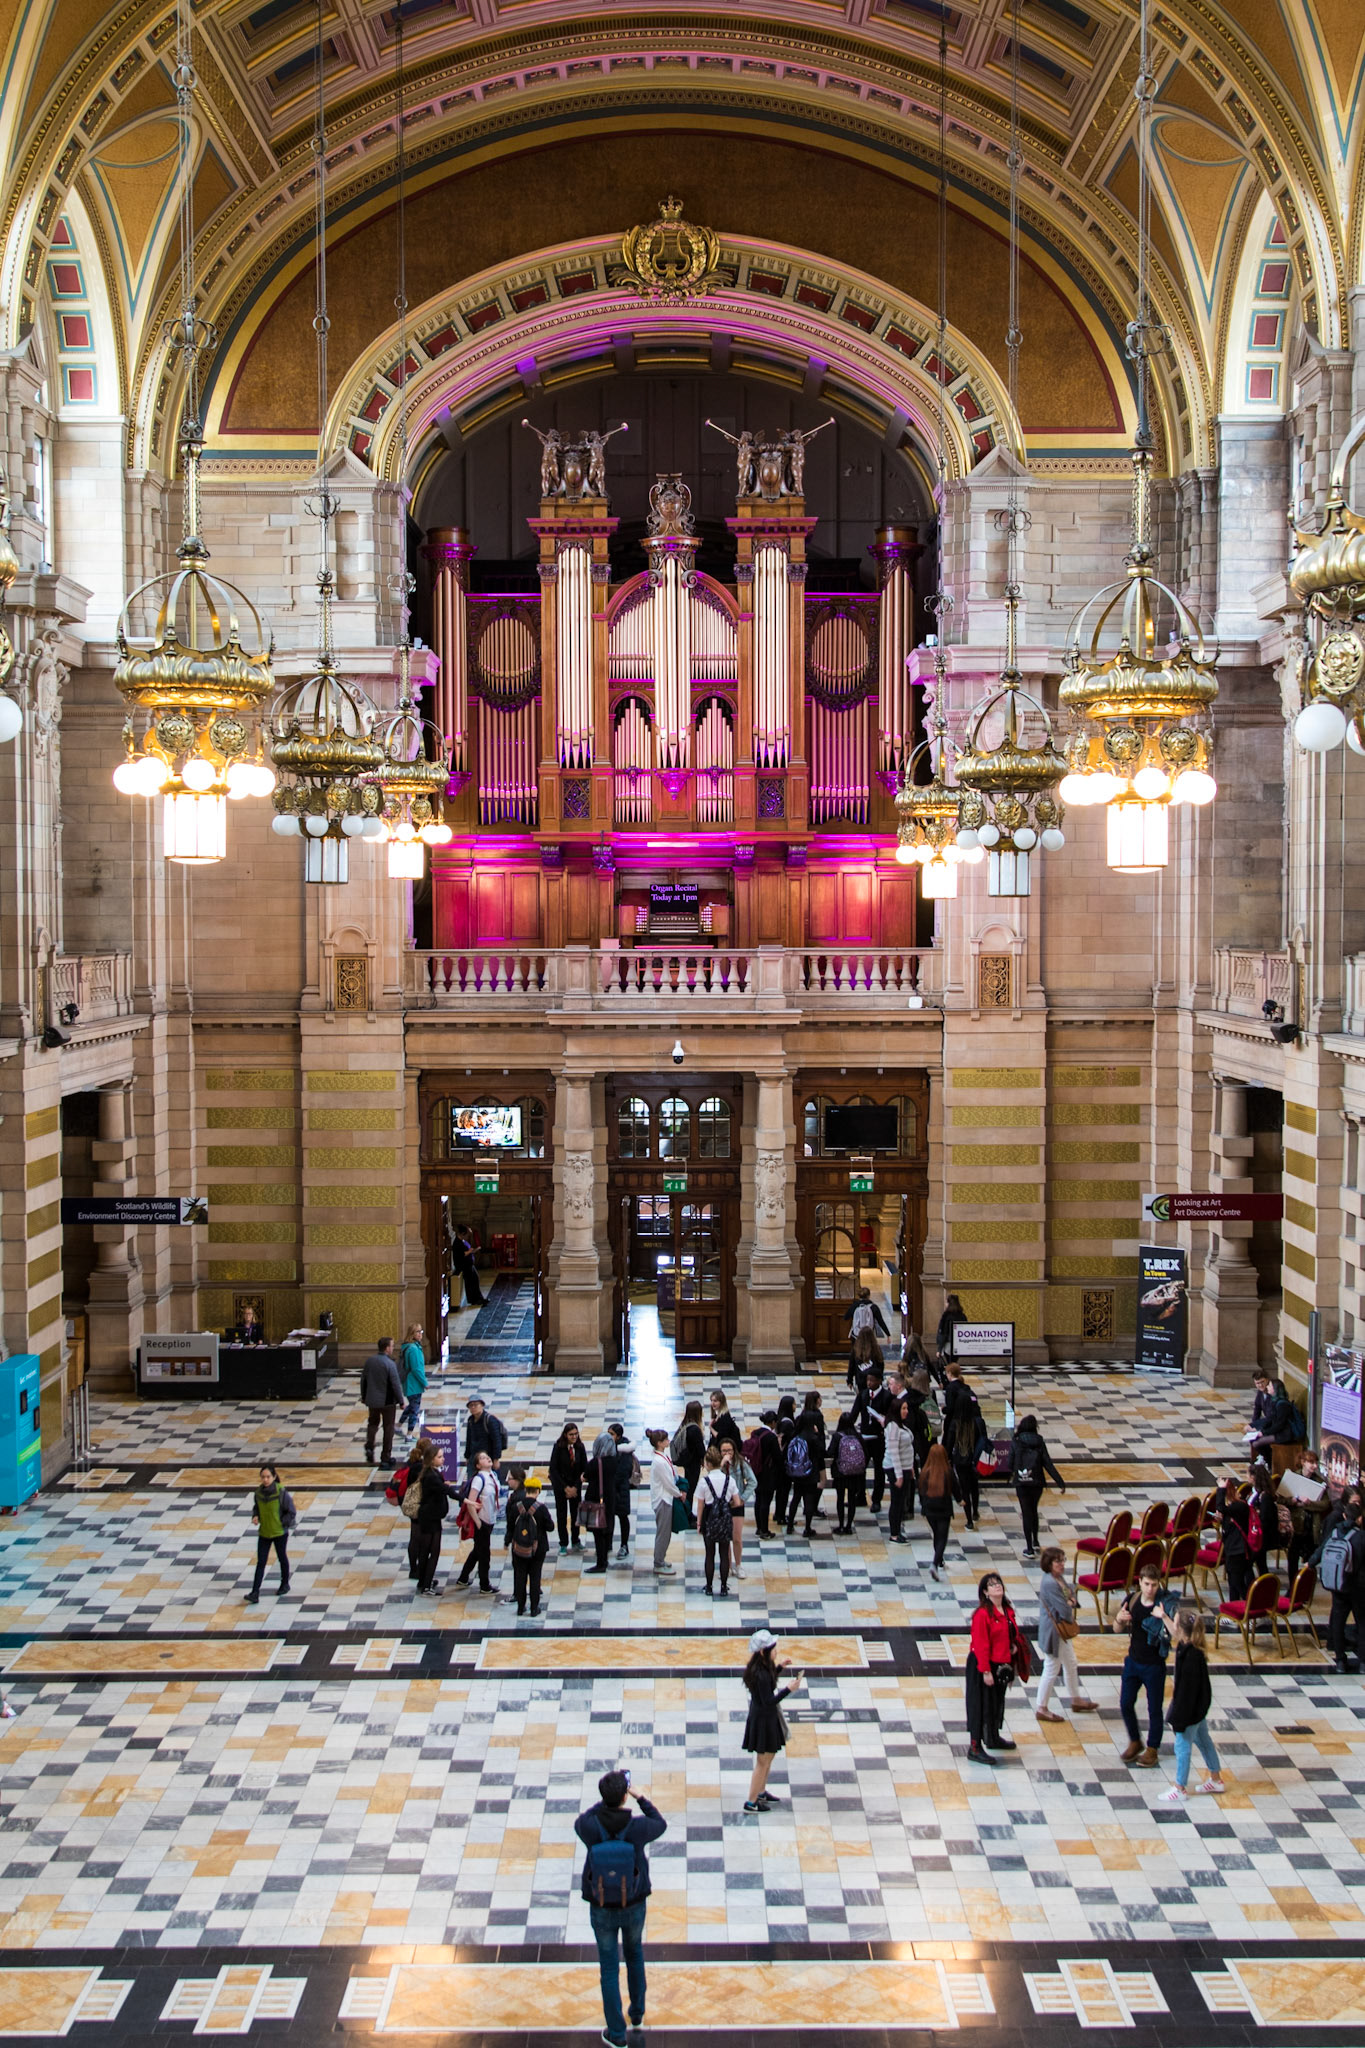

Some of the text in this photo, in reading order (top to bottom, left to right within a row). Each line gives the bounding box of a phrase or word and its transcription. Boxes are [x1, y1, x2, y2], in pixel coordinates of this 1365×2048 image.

[651, 884, 673, 893] Organ
[651, 893, 672, 903] Today
[682, 893, 697, 903] 1pm
[116, 1202, 176, 1210] Scotland's Wildlife
[1174, 1199, 1201, 1207] Looking
[78, 1212, 176, 1221] Environment Discovery Centre
[1186, 1209, 1219, 1217] Discovery
[1143, 1258, 1180, 1271] T.REX
[957, 1330, 1008, 1338] DONATIONS
[146, 1339, 191, 1350] Reception
